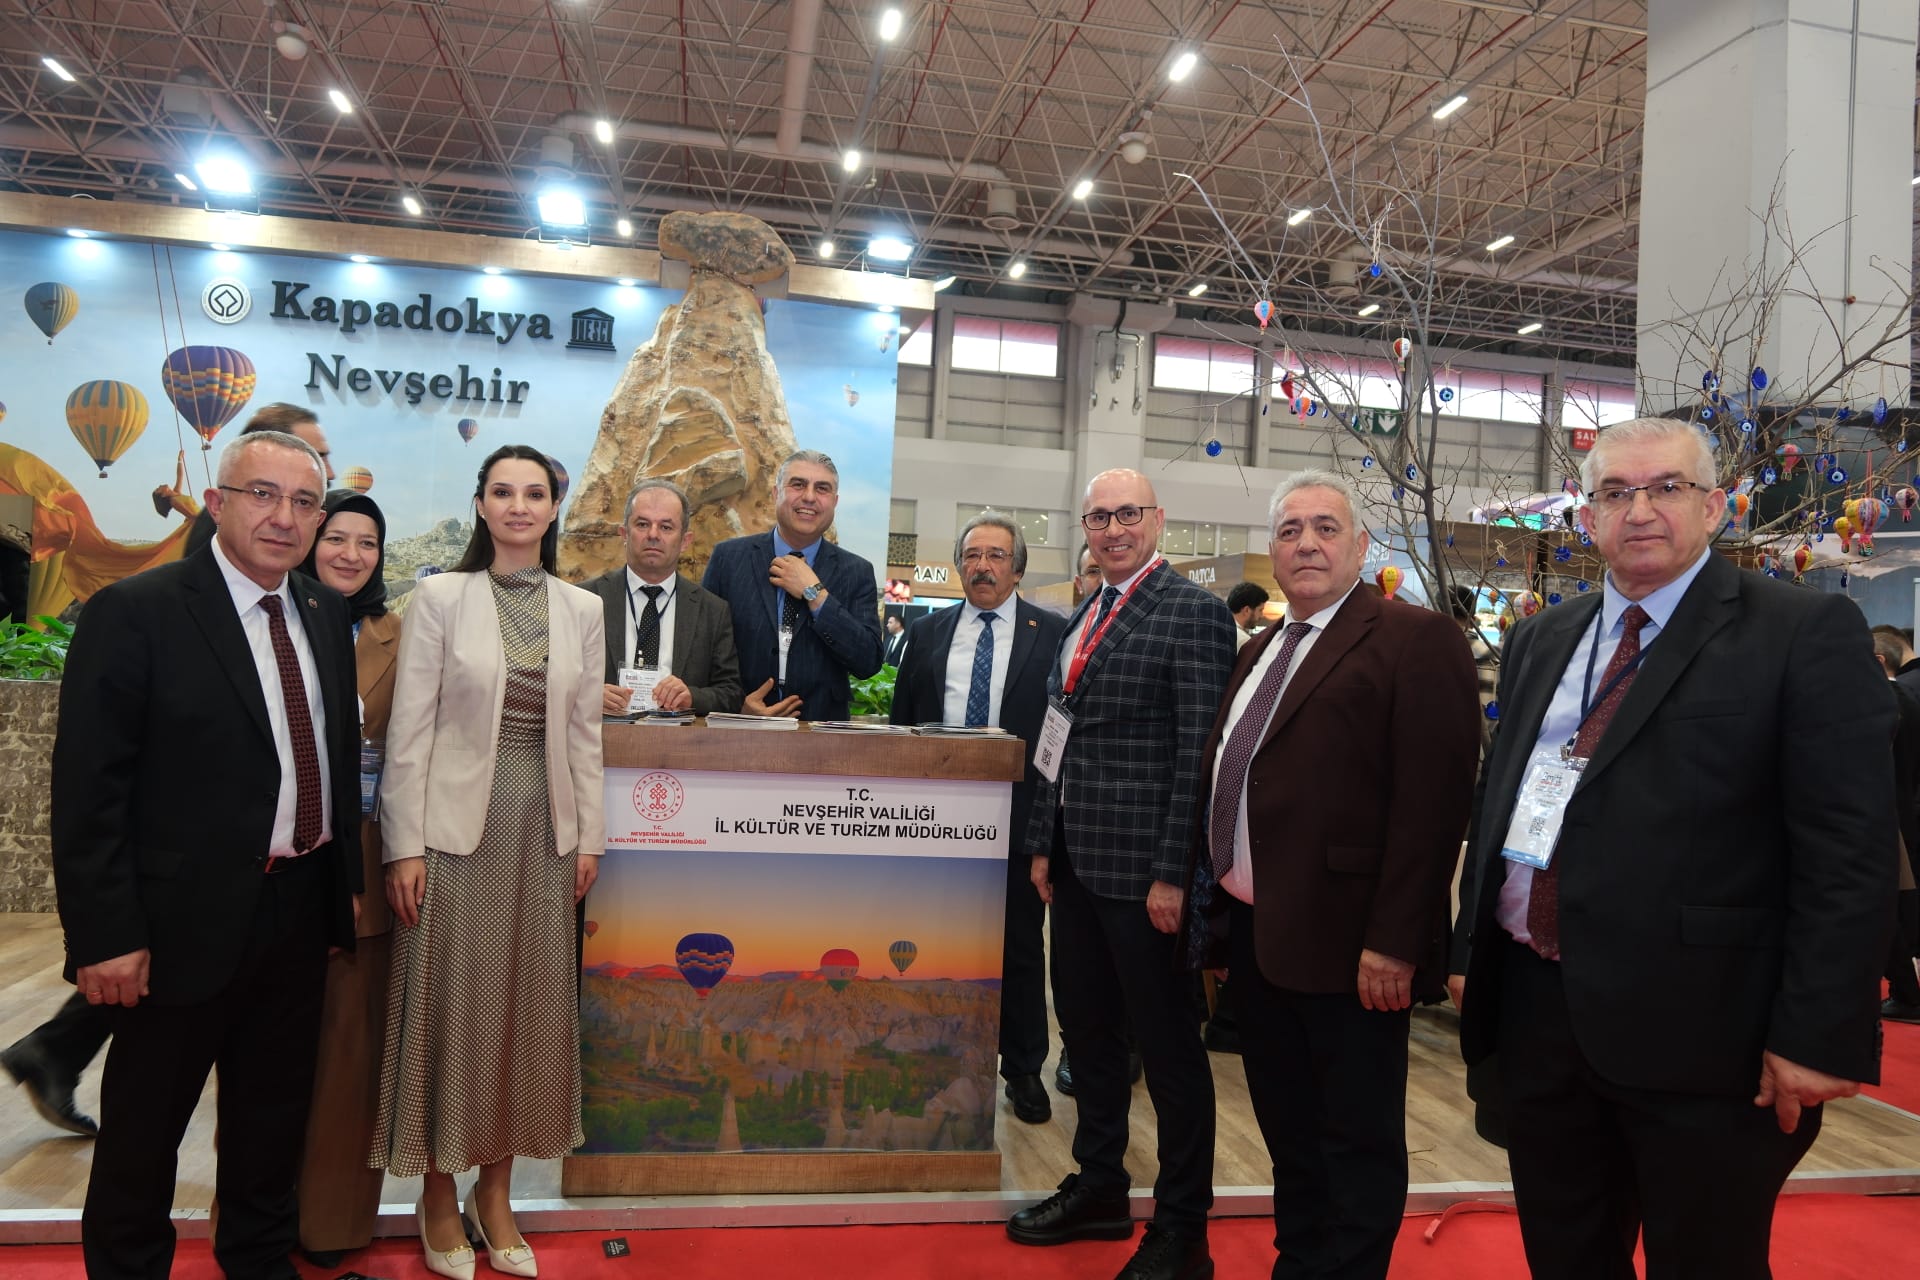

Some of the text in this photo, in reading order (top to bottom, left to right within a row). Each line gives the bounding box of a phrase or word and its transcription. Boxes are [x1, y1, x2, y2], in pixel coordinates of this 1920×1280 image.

[270, 280, 554, 345] Kapadokya
[304, 352, 530, 404] Nevşehir
[1189, 567, 1216, 587] DATÇA
[846, 788, 874, 801] T.C.
[783, 803, 935, 821] NEVŞEHİR VALİLİĞİ
[715, 817, 997, 840] İL KÜLTÜR VE TURİZM MÜDÜRLÜĞÜ
